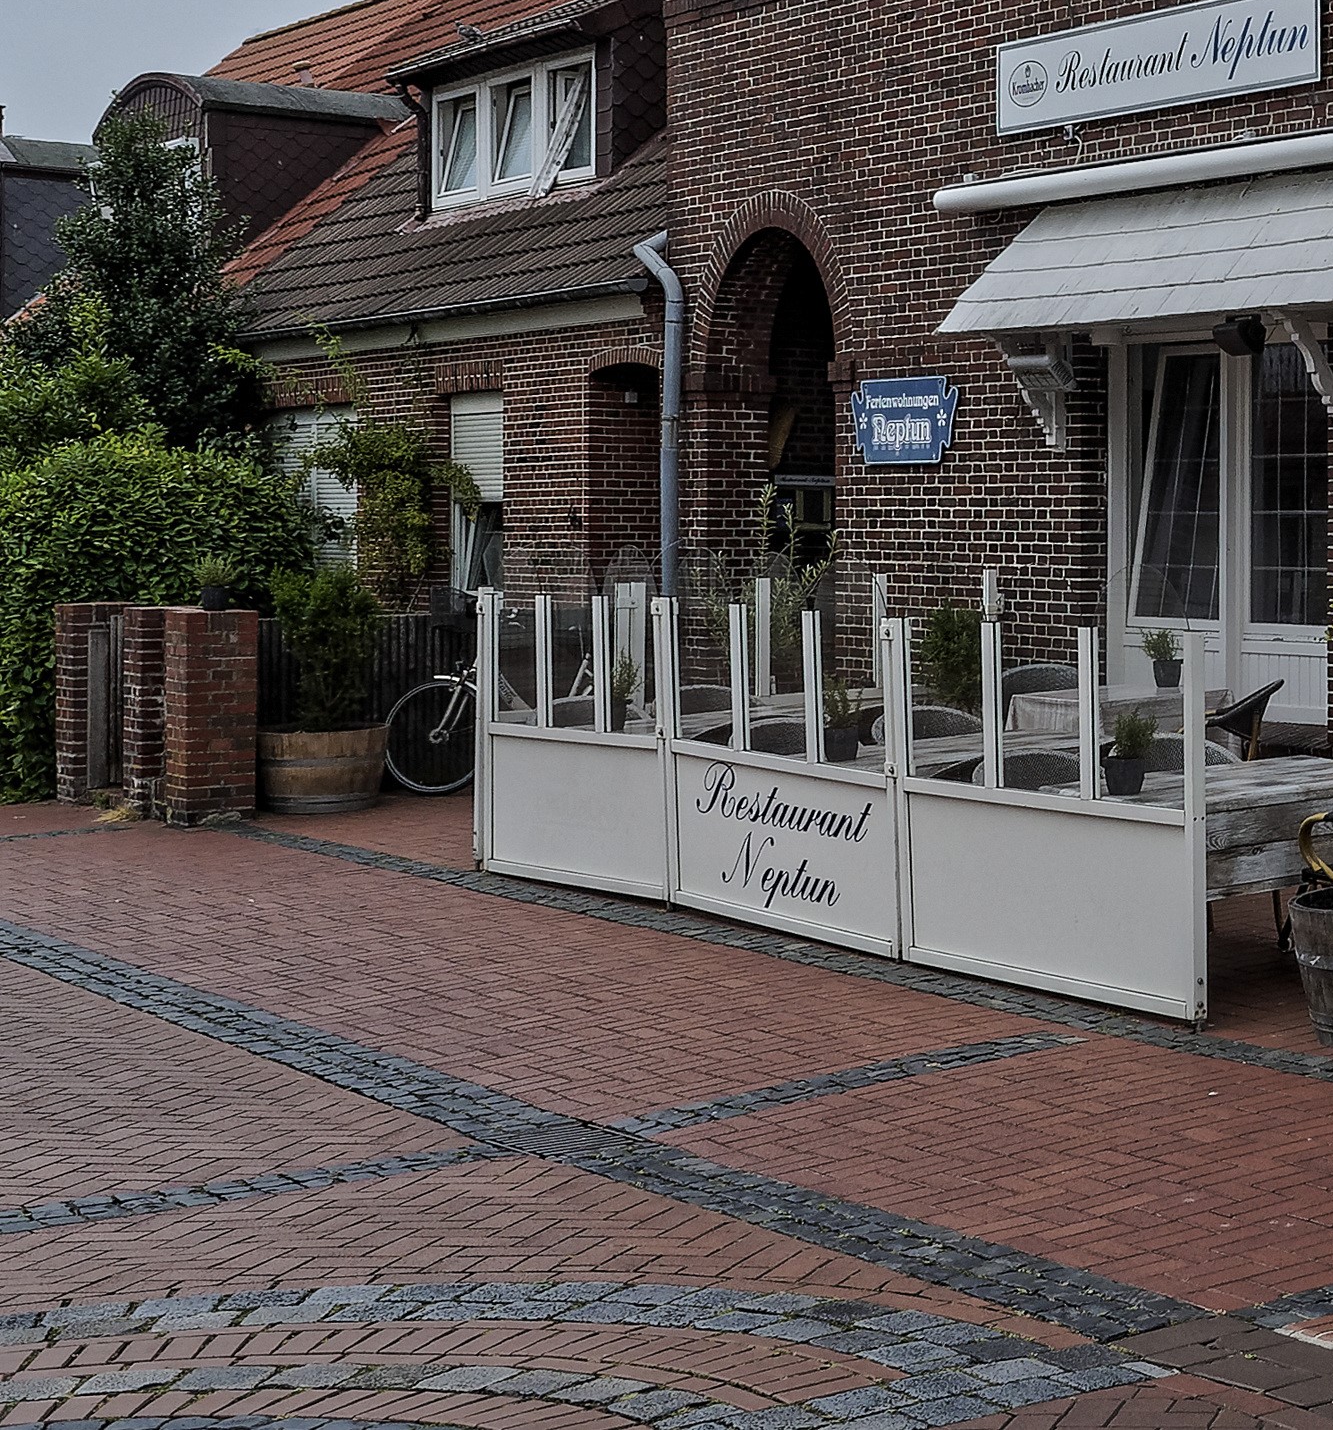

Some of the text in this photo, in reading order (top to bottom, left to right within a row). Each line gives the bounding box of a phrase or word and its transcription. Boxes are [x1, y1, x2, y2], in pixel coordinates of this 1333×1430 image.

[1055, 10, 1309, 93] Restaurant Neptun
[865, 393, 939, 410] Ferienwohnungen
[872, 414, 932, 450] Neptun
[696, 761, 873, 843] Restaurant
[721, 831, 841, 909] Neptun
